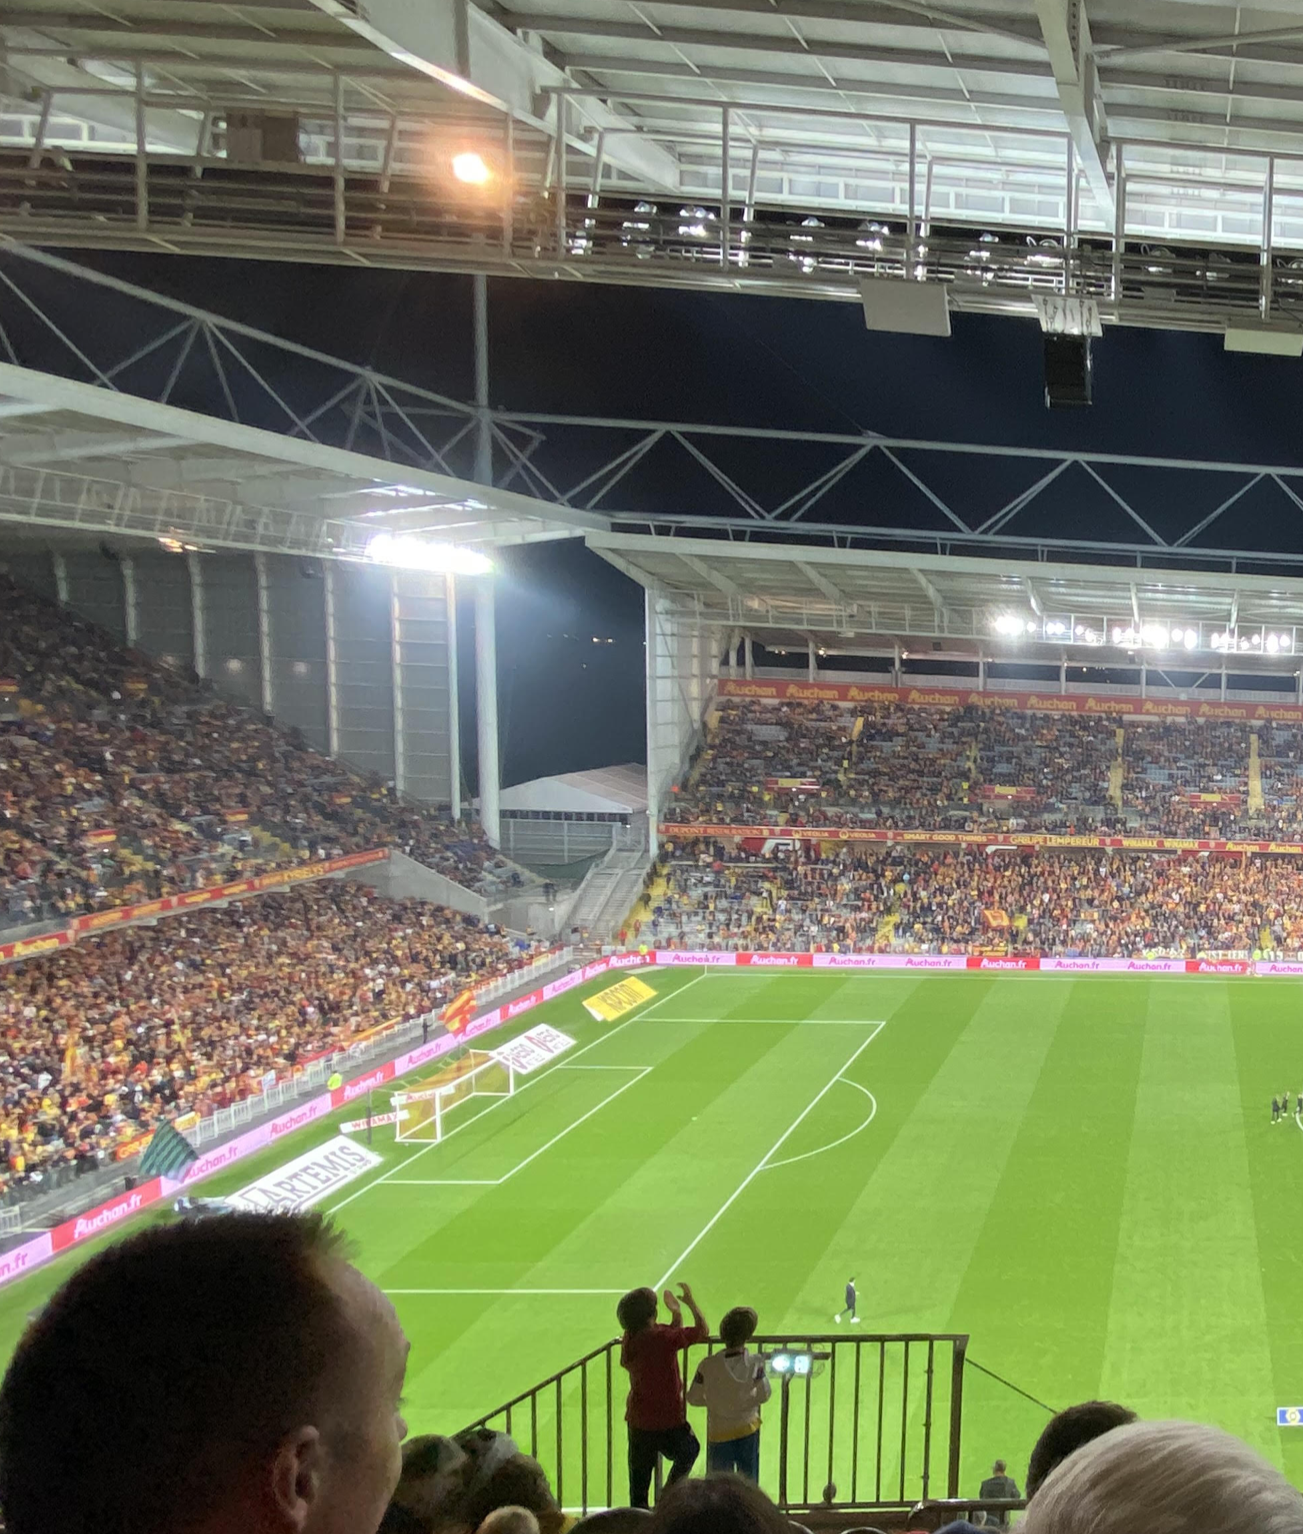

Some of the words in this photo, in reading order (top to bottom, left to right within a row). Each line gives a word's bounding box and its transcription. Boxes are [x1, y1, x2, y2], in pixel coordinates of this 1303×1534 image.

[724, 682, 776, 696] Auchan
[786, 684, 839, 700] Auchan
[908, 690, 959, 704] Auchan
[1027, 695, 1076, 710] Auchan
[1085, 698, 1134, 712] Auchan
[1142, 701, 1191, 715] Auchan
[1255, 706, 1302, 720] Auchan
[903, 833, 930, 841] SMART
[958, 834, 988, 842] THINGS
[1047, 837, 1100, 846] LEMPEREUR
[1122, 839, 1157, 848] WINAMAX
[1164, 840, 1198, 849] WINAMAX
[1226, 841, 1259, 852] Auchan
[1268, 842, 1302, 853] Auchan
[751, 954, 798, 965] Auchan.fr
[829, 956, 876, 966] Auchan.fr
[905, 957, 952, 968] Auchan.fr
[980, 958, 1027, 969] Auchan.fr
[1055, 959, 1099, 969] Auchan.fr
[1127, 960, 1171, 971] Auchan.fr
[407, 1042, 442, 1068] Auchan.fr
[344, 1071, 383, 1100] Auchan.fr
[270, 1105, 318, 1138] Auchan.fr
[253, 1145, 366, 1208] ARTEMIS
[75, 1193, 142, 1239] Auchan.fr
